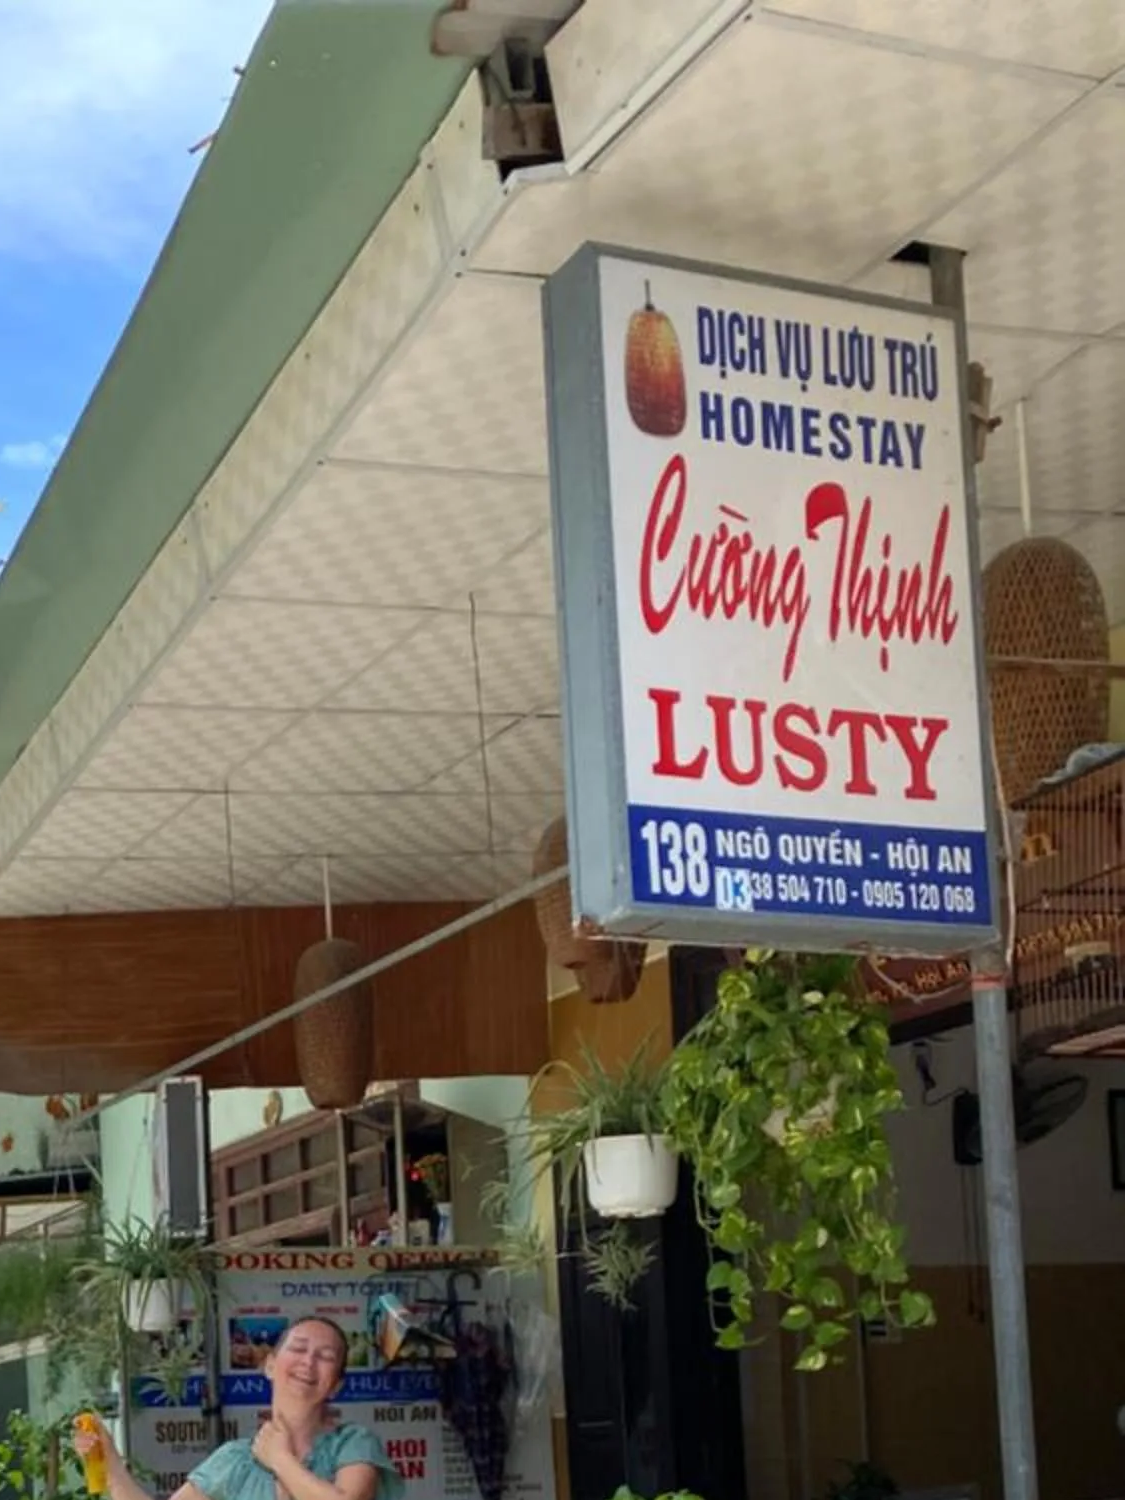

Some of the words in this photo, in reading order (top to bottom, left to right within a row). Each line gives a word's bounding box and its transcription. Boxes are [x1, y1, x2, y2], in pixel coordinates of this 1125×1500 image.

[697, 306, 767, 379] DỊCH
[774, 319, 813, 392] VỤ
[822, 326, 875, 391] LƯU
[884, 332, 939, 401] TRÚ
[699, 391, 925, 470] HOMESTAY
[640, 453, 811, 683] Cường
[805, 482, 959, 672] Thịnh
[647, 688, 949, 800] LUSTY
[641, 820, 711, 898] 138
[715, 826, 771, 861] NGÔ
[887, 837, 930, 877] HỘI
[938, 845, 973, 875] AN
[777, 873, 811, 903] 504
[813, 876, 847, 905] 710
[862, 879, 905, 910] 0905
[909, 883, 940, 912] 120
[944, 885, 976, 913] 068
[281, 1281, 338, 1297] DAILY
[231, 1378, 264, 1394] AN
[374, 1407, 405, 1422] HOI
[410, 1405, 437, 1422] AN
[386, 1439, 427, 1459] HOI
